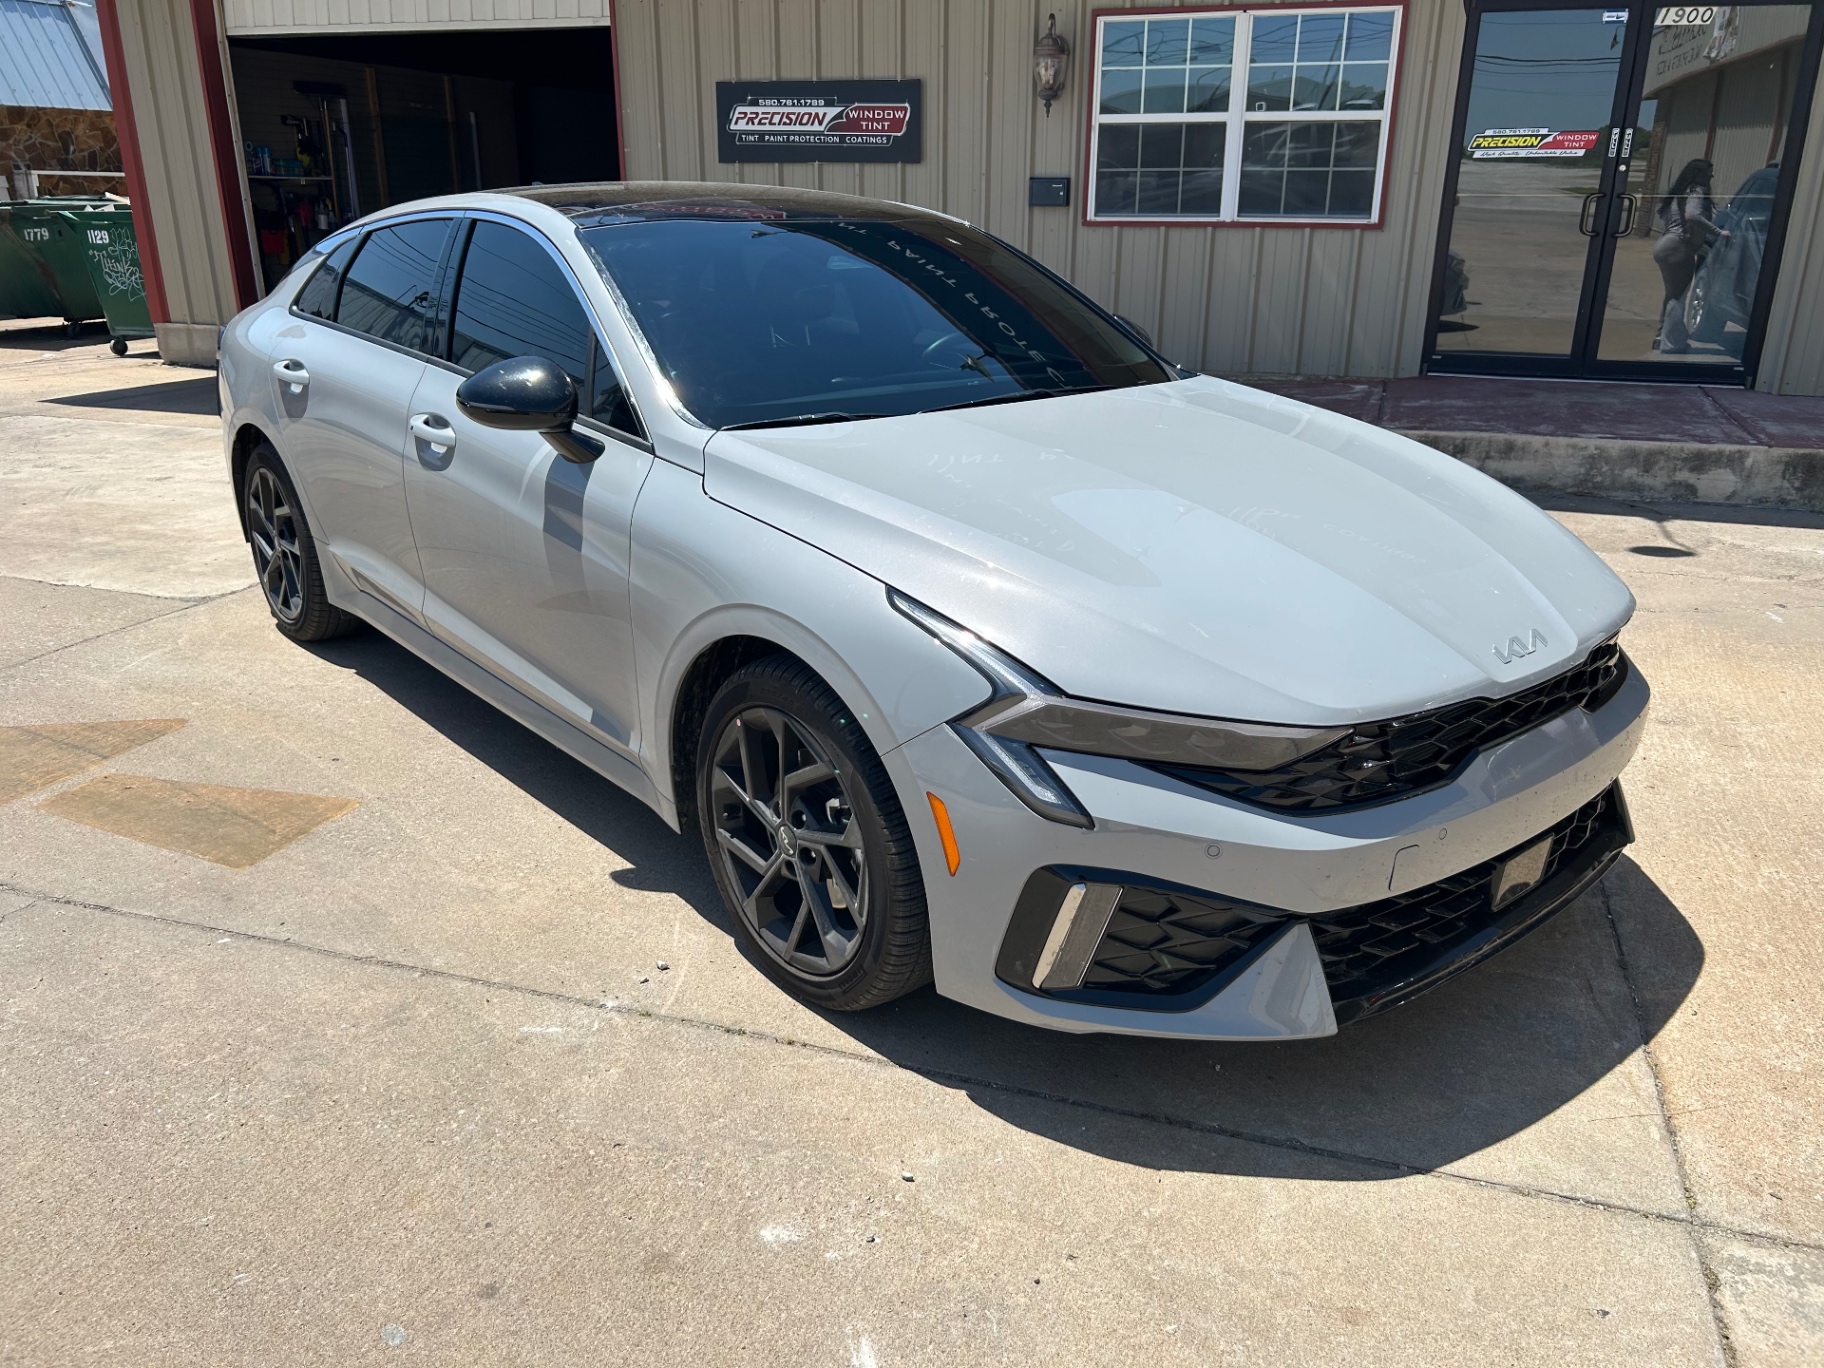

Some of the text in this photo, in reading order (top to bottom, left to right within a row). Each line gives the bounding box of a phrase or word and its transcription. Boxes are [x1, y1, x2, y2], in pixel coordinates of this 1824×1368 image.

[1660, 7, 1714, 24] 1900
[733, 111, 828, 127] PRECISION
[848, 110, 905, 119] WINDOW
[860, 122, 891, 130] TINT
[741, 134, 760, 142] TINT
[789, 135, 840, 143] PROTECTION
[845, 136, 887, 144] COATINGS
[1472, 136, 1542, 147] PRECISION
[24, 227, 49, 241] 1779
[87, 229, 109, 244] 1129
[1491, 628, 1548, 664] KIA
